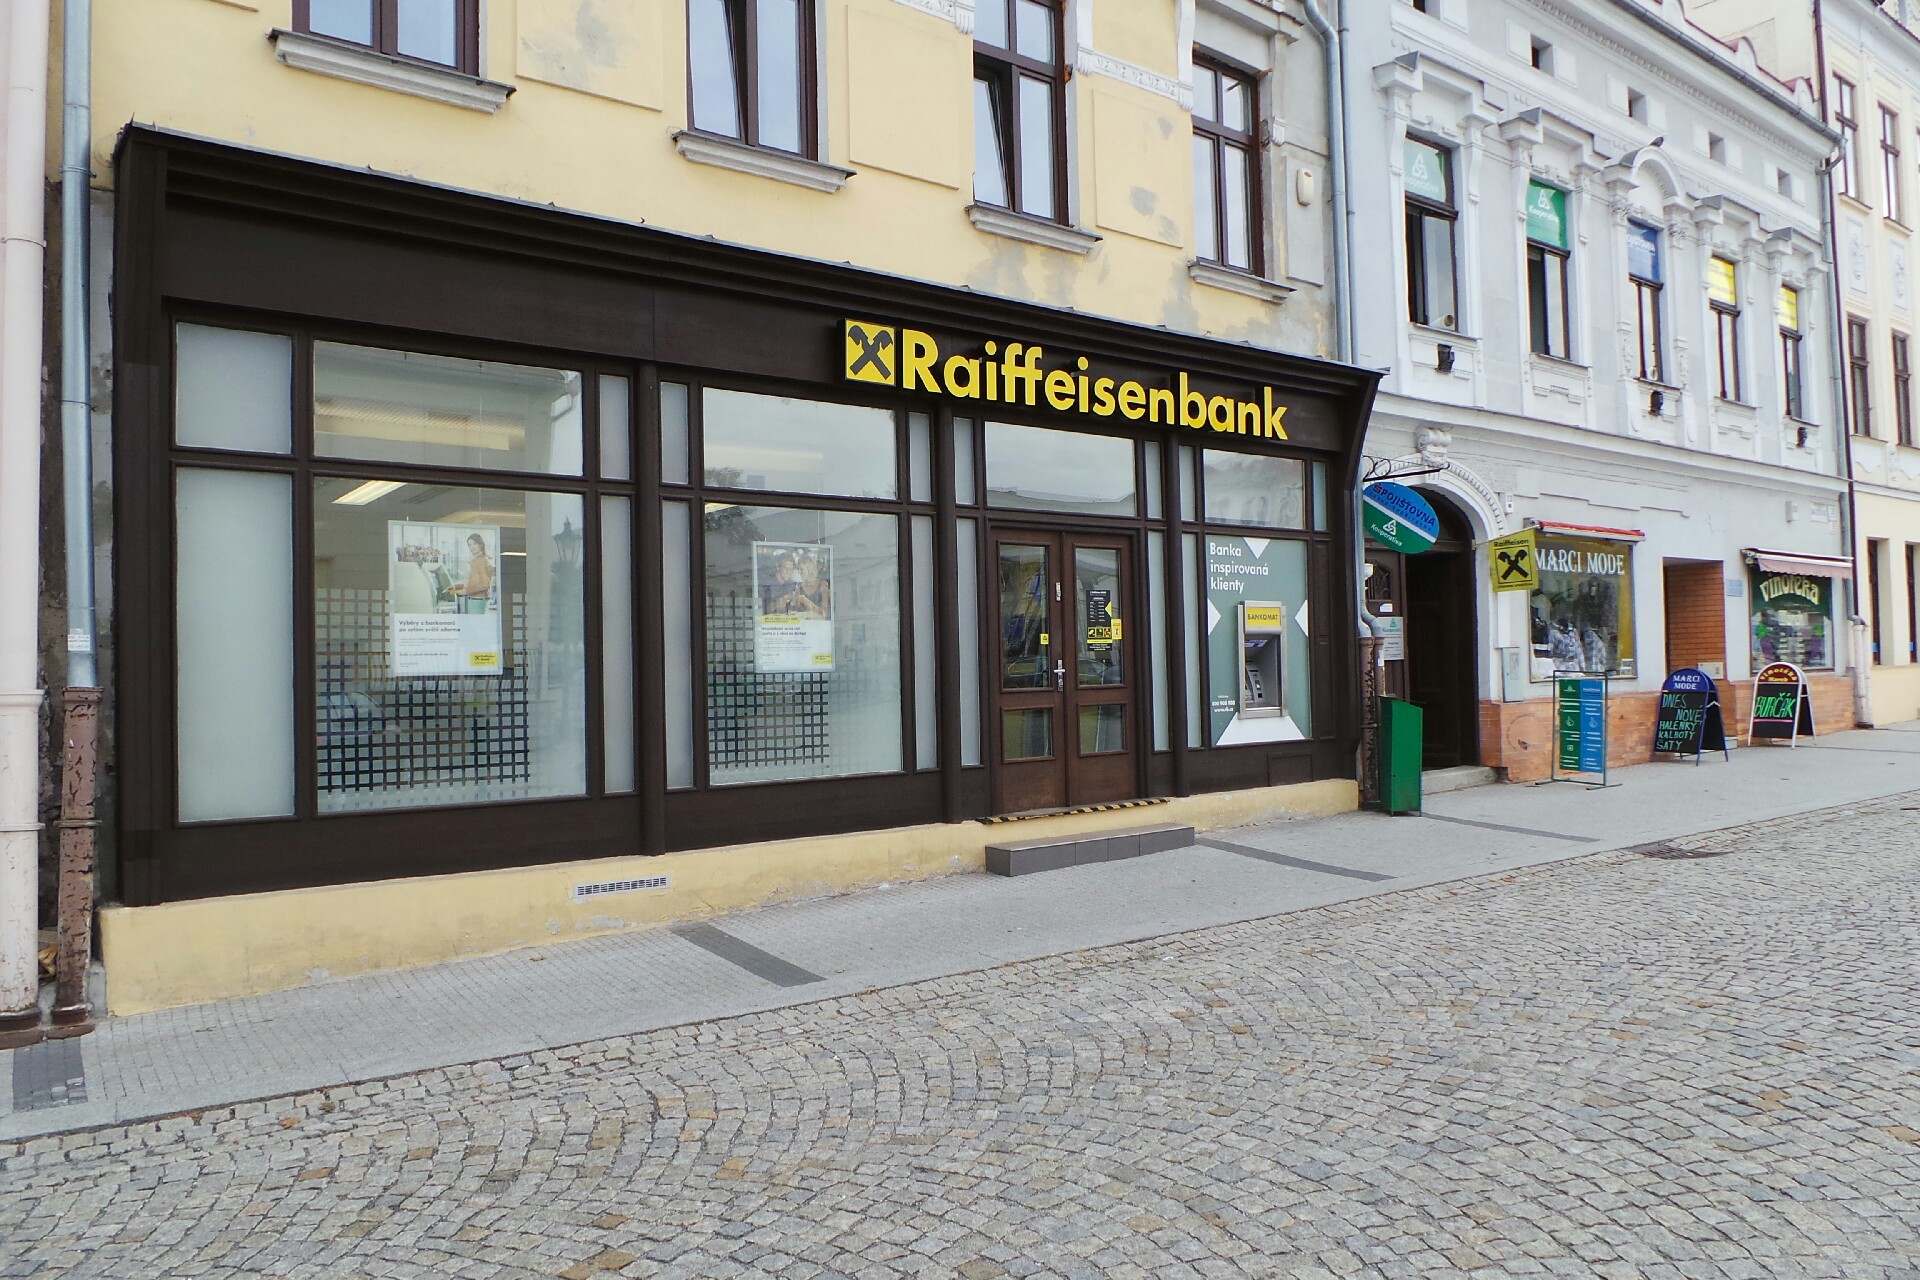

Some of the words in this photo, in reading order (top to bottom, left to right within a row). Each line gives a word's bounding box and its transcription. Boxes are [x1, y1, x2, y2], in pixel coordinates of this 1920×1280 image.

[902, 329, 1289, 440] Raiffeisenbank
[1370, 523, 1403, 547] Kooperativa
[1209, 542, 1242, 557] Banka
[1494, 539, 1529, 548] Raiffeisen
[1210, 559, 1269, 576] inspirovaná
[1534, 548, 1583, 573] MARCI
[1587, 552, 1625, 576] MODE
[1210, 576, 1244, 594] klienty
[1247, 613, 1278, 621] BANKOMAT
[1674, 682, 1697, 690] MODE
[1662, 694, 1687, 708] DNES
[1753, 692, 1797, 718] BURČÁK
[1676, 705, 1704, 722] NOVÉ
[1659, 721, 1697, 731] HALENKY
[1658, 731, 1695, 740] KALHOTY
[1656, 739, 1682, 750] ŠATY
